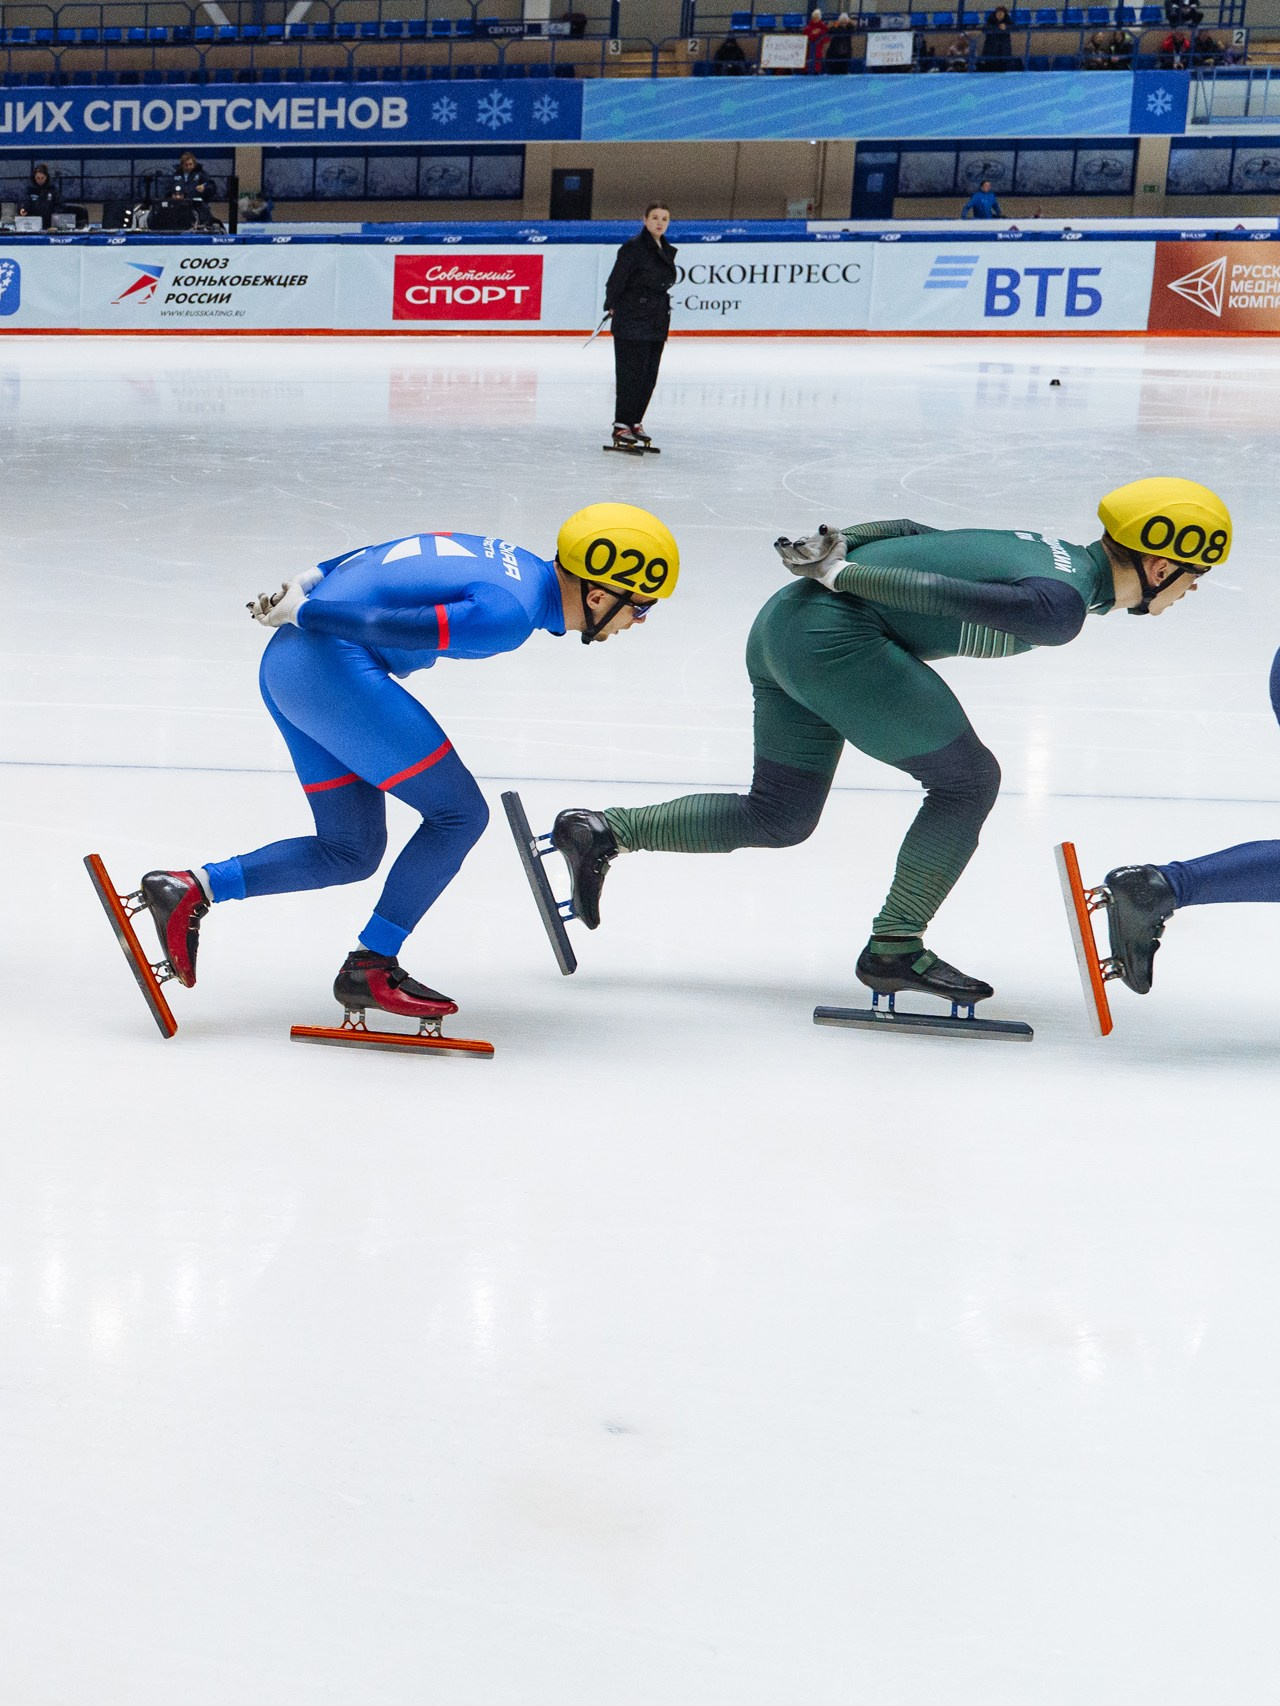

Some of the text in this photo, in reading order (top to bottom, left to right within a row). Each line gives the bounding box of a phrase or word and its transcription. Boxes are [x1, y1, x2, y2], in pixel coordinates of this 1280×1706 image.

[1235, 31, 1244, 44] 2
[611, 40, 620, 52] 3
[688, 40, 698, 52] 2
[83, 97, 408, 132] СПОРТСМЕНОВ
[180, 258, 230, 269] СОЮЗ
[425, 265, 516, 282] Советский
[674, 264, 862, 285] ОСКОНГРЕСС
[171, 275, 309, 288] КОНЬКОБЕЖЦЕВ
[1230, 280, 1280, 293] МЕДН
[164, 293, 232, 305] РОССИИ
[405, 285, 531, 305] СПОРТ
[984, 267, 1103, 317] ВТБ
[1140, 515, 1228, 564] 008
[584, 537, 670, 595] 029
